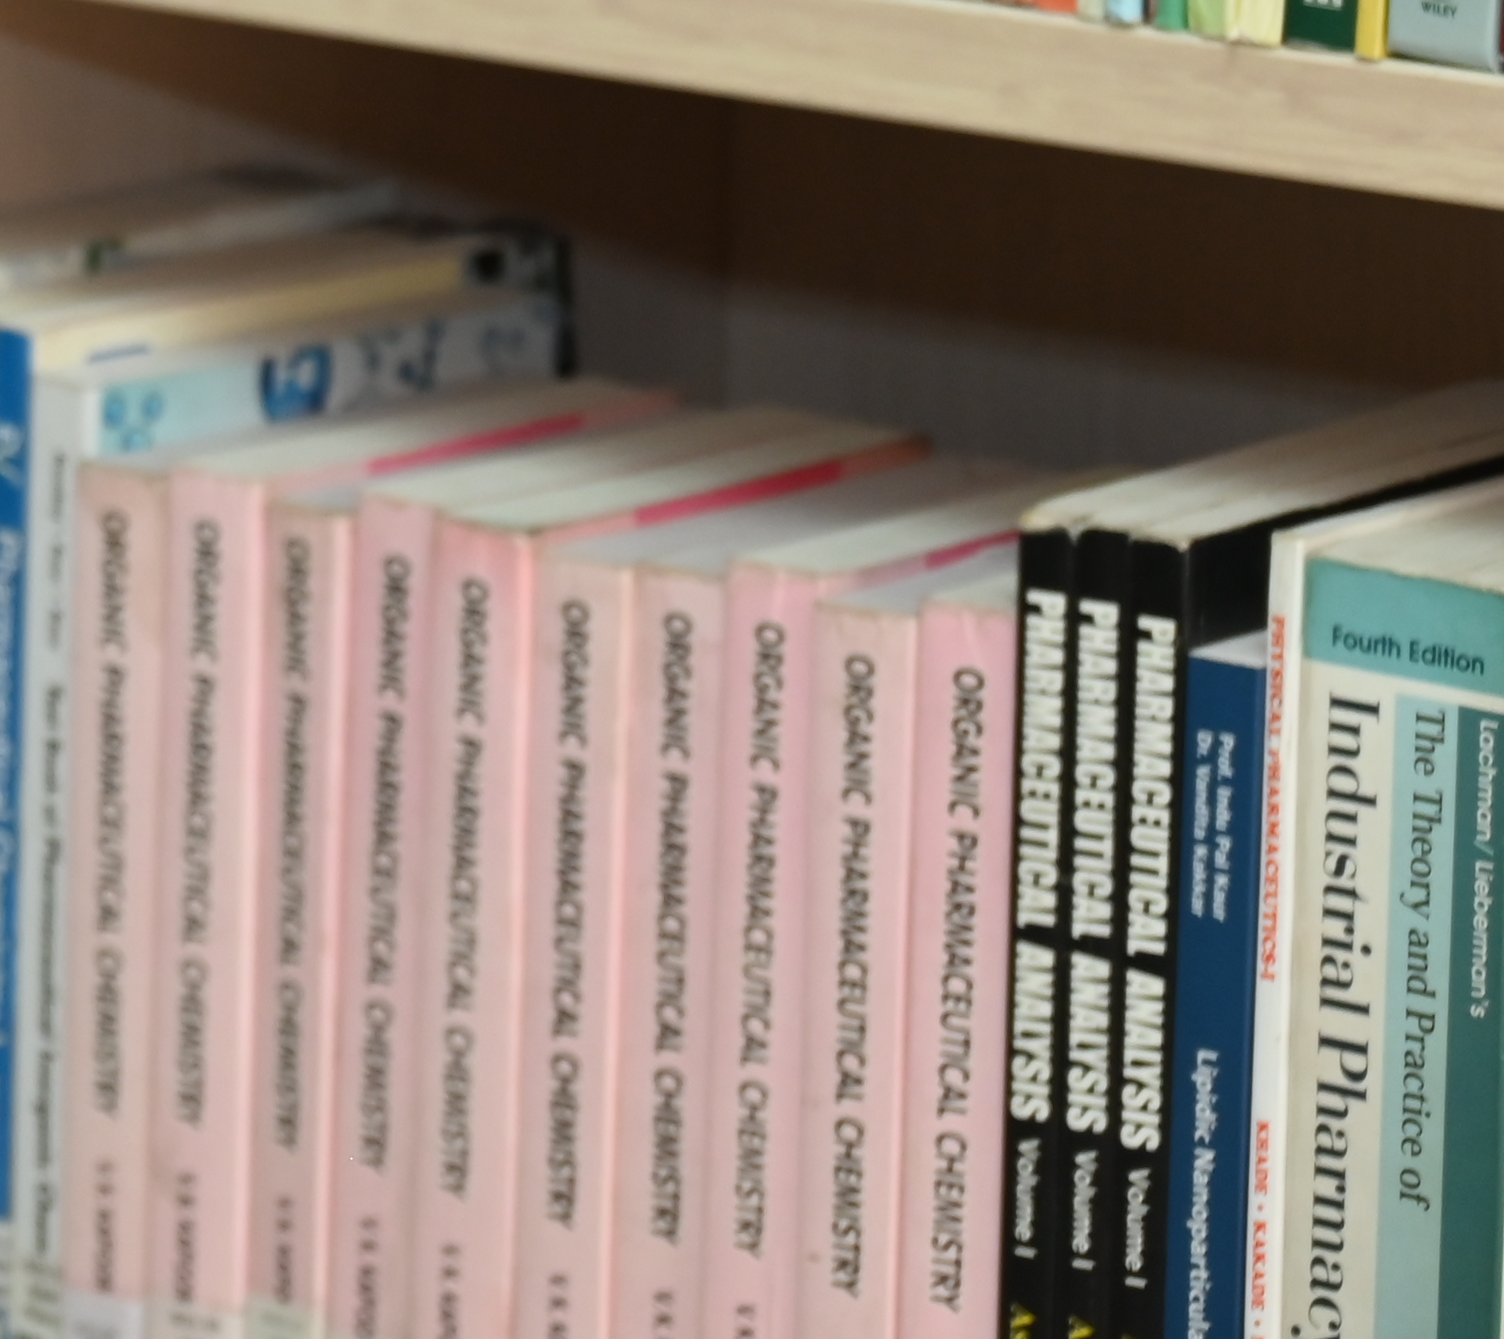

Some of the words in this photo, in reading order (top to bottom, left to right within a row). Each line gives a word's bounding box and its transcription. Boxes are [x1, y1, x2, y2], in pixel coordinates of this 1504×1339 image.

[1421, 1, 1457, 18] WILEY
[751, 622, 786, 773] ORGANIC
[1266, 616, 1286, 740] PHYSICAL
[1331, 624, 1402, 663] Fourth
[1407, 641, 1486, 677] Edition
[840, 654, 875, 807] ORGANIC
[948, 666, 985, 820] ORGANIC
[1017, 588, 1067, 930] PHARMACEUTICAL
[1070, 598, 1120, 940] PHARMACEUTICAL
[1127, 613, 1177, 956] PHARMACEUTICAL
[1197, 729, 1213, 759] Dr.
[1217, 732, 1235, 780] Prof.
[1413, 709, 1447, 777] The
[1473, 718, 1497, 851] Lachman/
[1192, 764, 1210, 840] Vandita
[1213, 835, 1231, 870] Pal
[1215, 786, 1234, 831] Indu
[1260, 750, 1284, 982] PHARMACEUTICS-I
[1317, 692, 1380, 1017] Industrial
[1400, 791, 1443, 921] Theory
[739, 780, 779, 1067] PHARMACEUTICAL
[1191, 845, 1209, 919] Kakkar
[1211, 874, 1229, 922] Kaur
[1469, 860, 1495, 1018] Lieberman's
[835, 814, 872, 1106] PHARMACEUTICAL
[937, 829, 979, 1120] PHARMACEUTICAL
[1405, 928, 1436, 997] and
[1009, 939, 1057, 1121] ANALYSIS
[1066, 951, 1113, 1134] ANALYSIS
[1120, 967, 1166, 1151] ANALYSIS
[1191, 1048, 1219, 1143] Lipidic
[1400, 1008, 1437, 1155] Practice
[735, 1080, 770, 1259] CHEMISTRY
[831, 1116, 866, 1299] CHEMISTRY
[930, 1131, 968, 1313] CHEMISTRY
[1015, 1138, 1042, 1241] Volume
[1072, 1149, 1099, 1254] Volume
[1125, 1168, 1151, 1272] Volume
[1398, 1167, 1430, 1210] of
[1251, 1220, 1267, 1310] KAKADE
